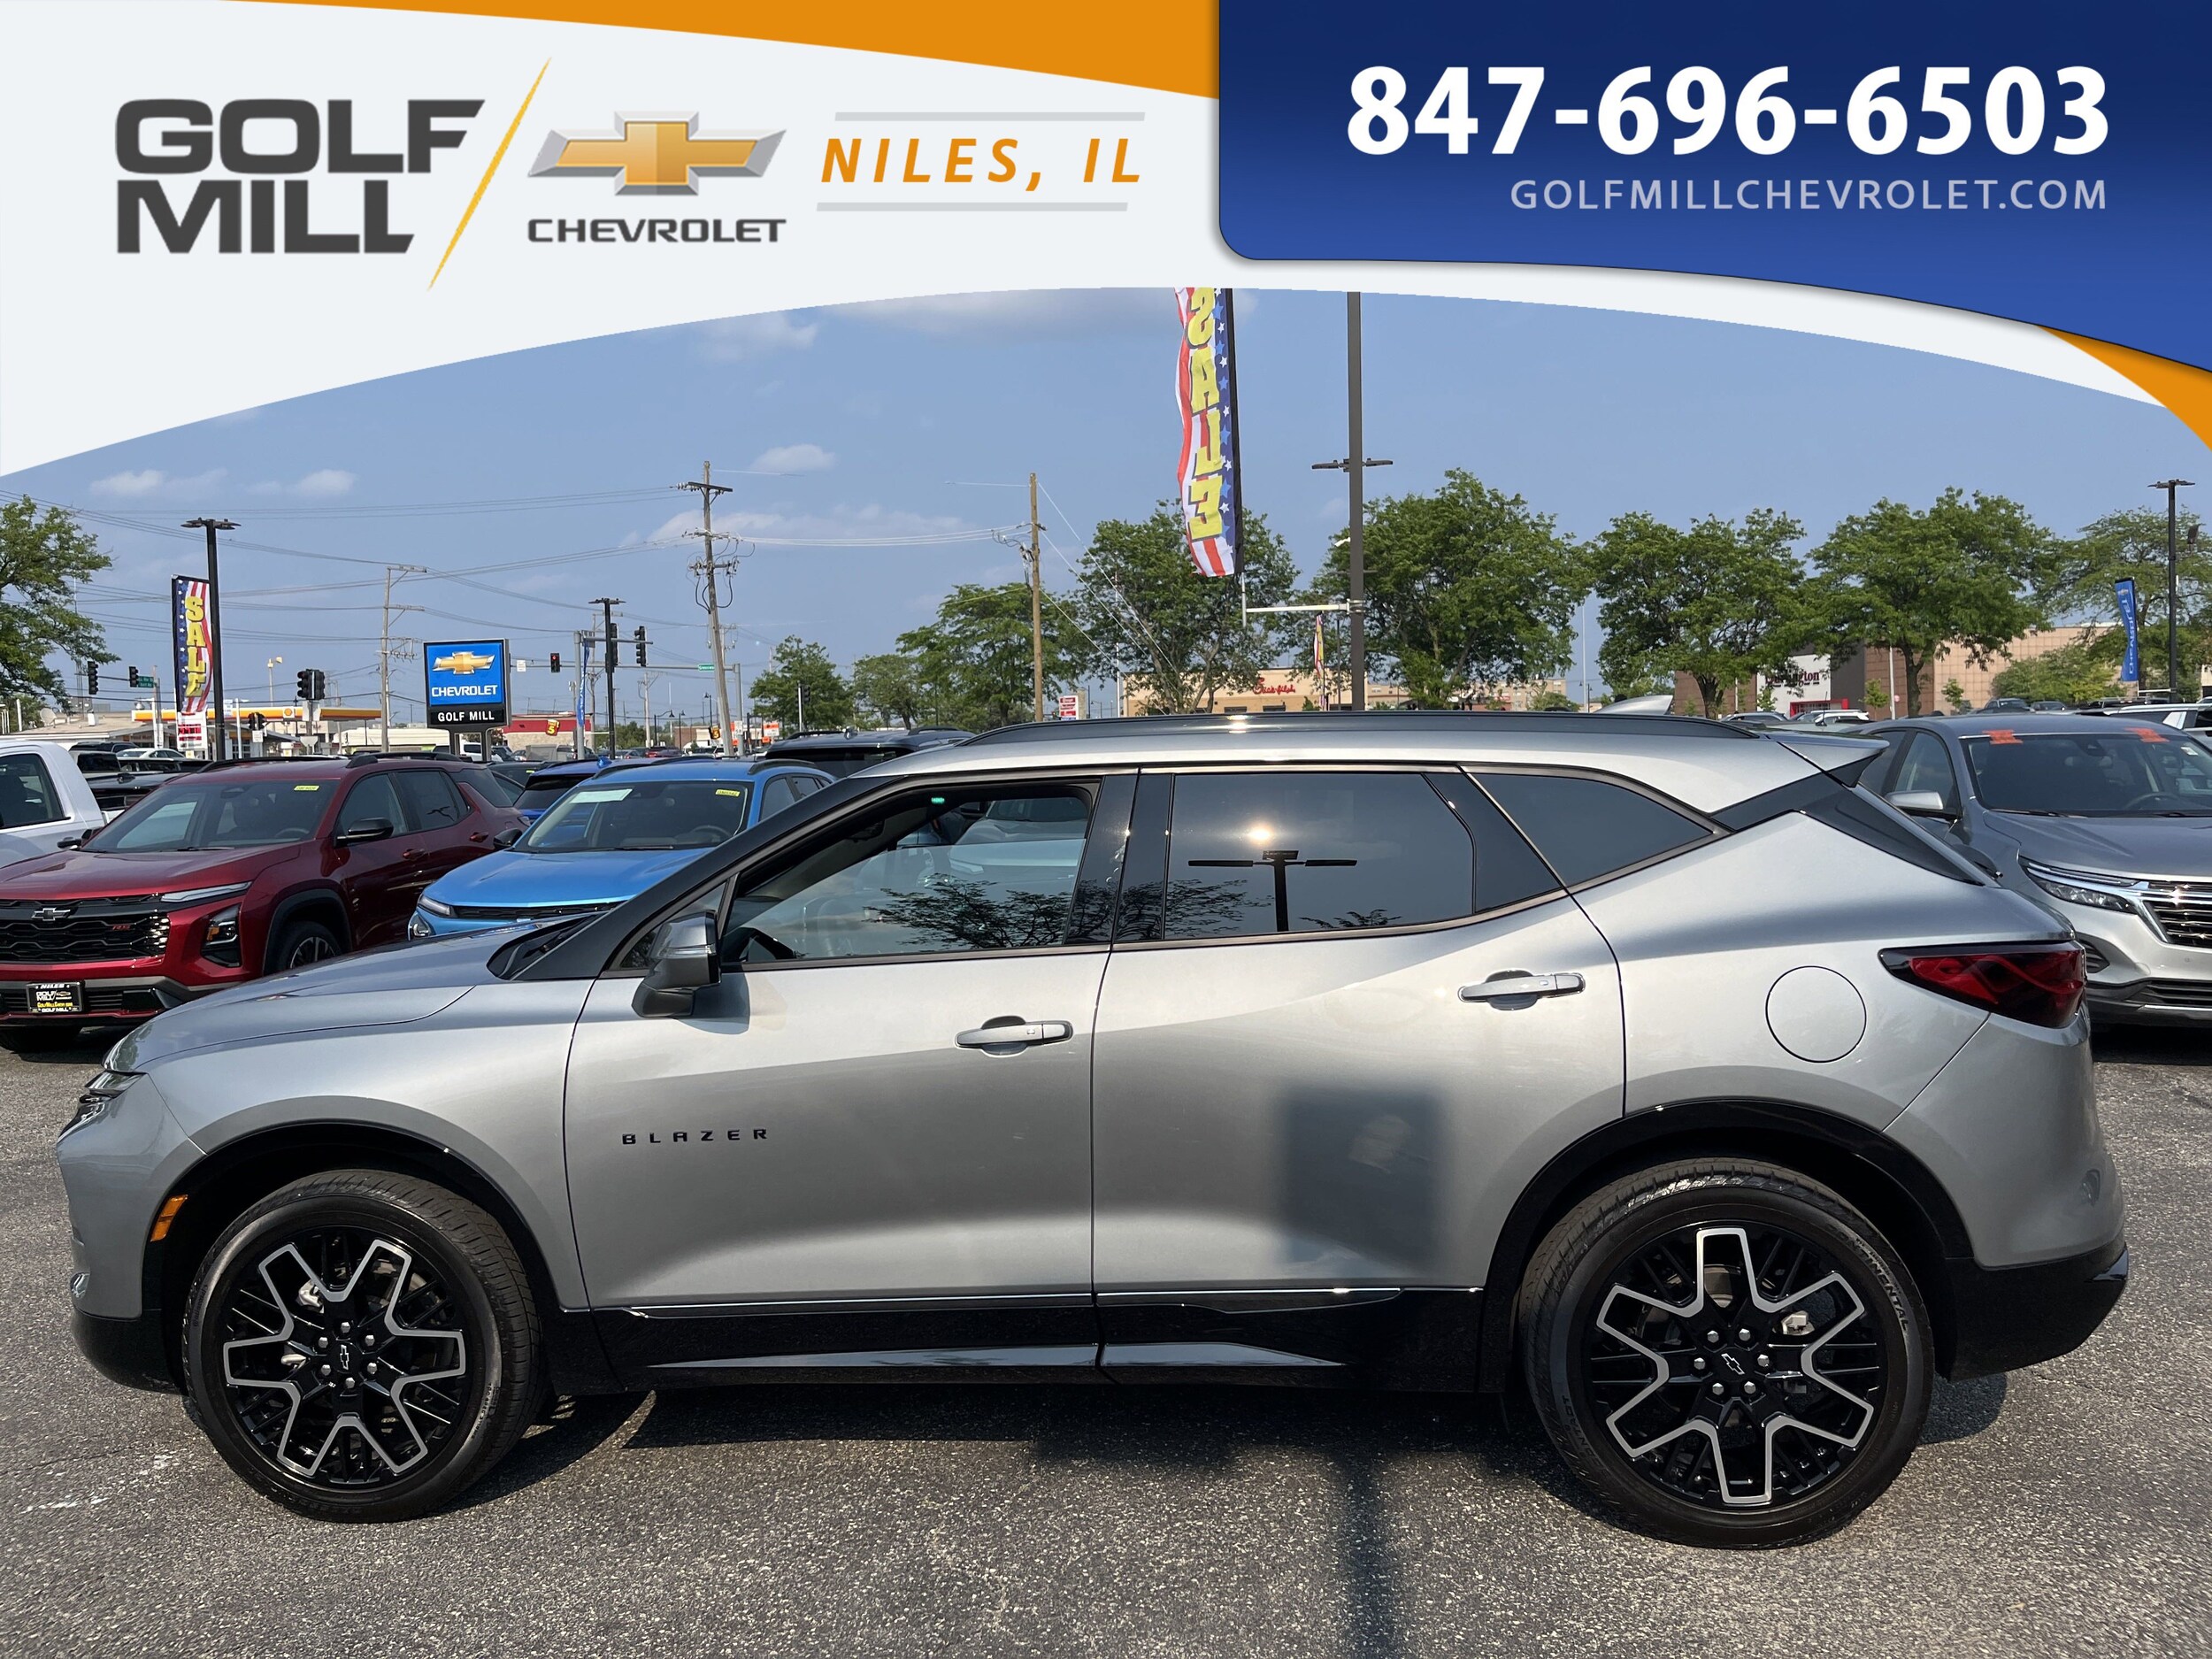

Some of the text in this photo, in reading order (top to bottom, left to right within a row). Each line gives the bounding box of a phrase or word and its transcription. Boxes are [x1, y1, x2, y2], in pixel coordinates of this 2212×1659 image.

[184, 595, 207, 697] SALE
[431, 685, 498, 697] CHEVROLET
[437, 710, 495, 722] GOLF MILL
[622, 1128, 768, 1145] BLAZER
